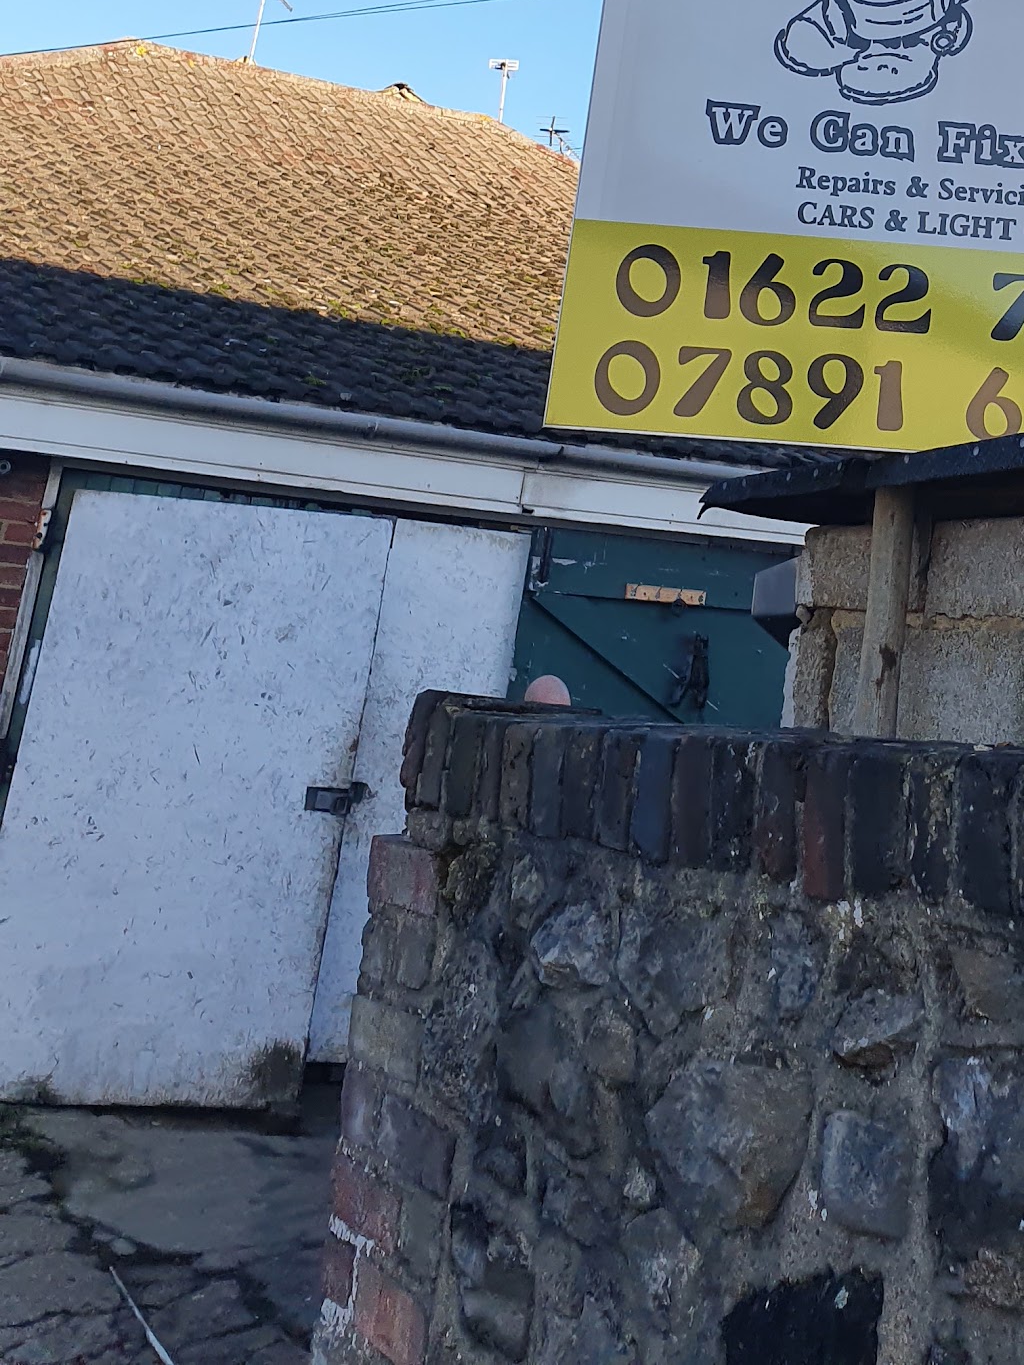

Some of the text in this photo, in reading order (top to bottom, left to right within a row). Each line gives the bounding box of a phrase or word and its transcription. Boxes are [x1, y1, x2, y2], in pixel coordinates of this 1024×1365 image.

[706, 99, 789, 148] We
[810, 110, 915, 162] Can
[796, 166, 897, 197] Repairs
[905, 175, 930, 198] &
[797, 201, 875, 230] CARS
[884, 209, 908, 232] &
[917, 211, 1017, 241] LIGHT
[615, 243, 931, 335] 01622
[595, 339, 905, 432] 07891
